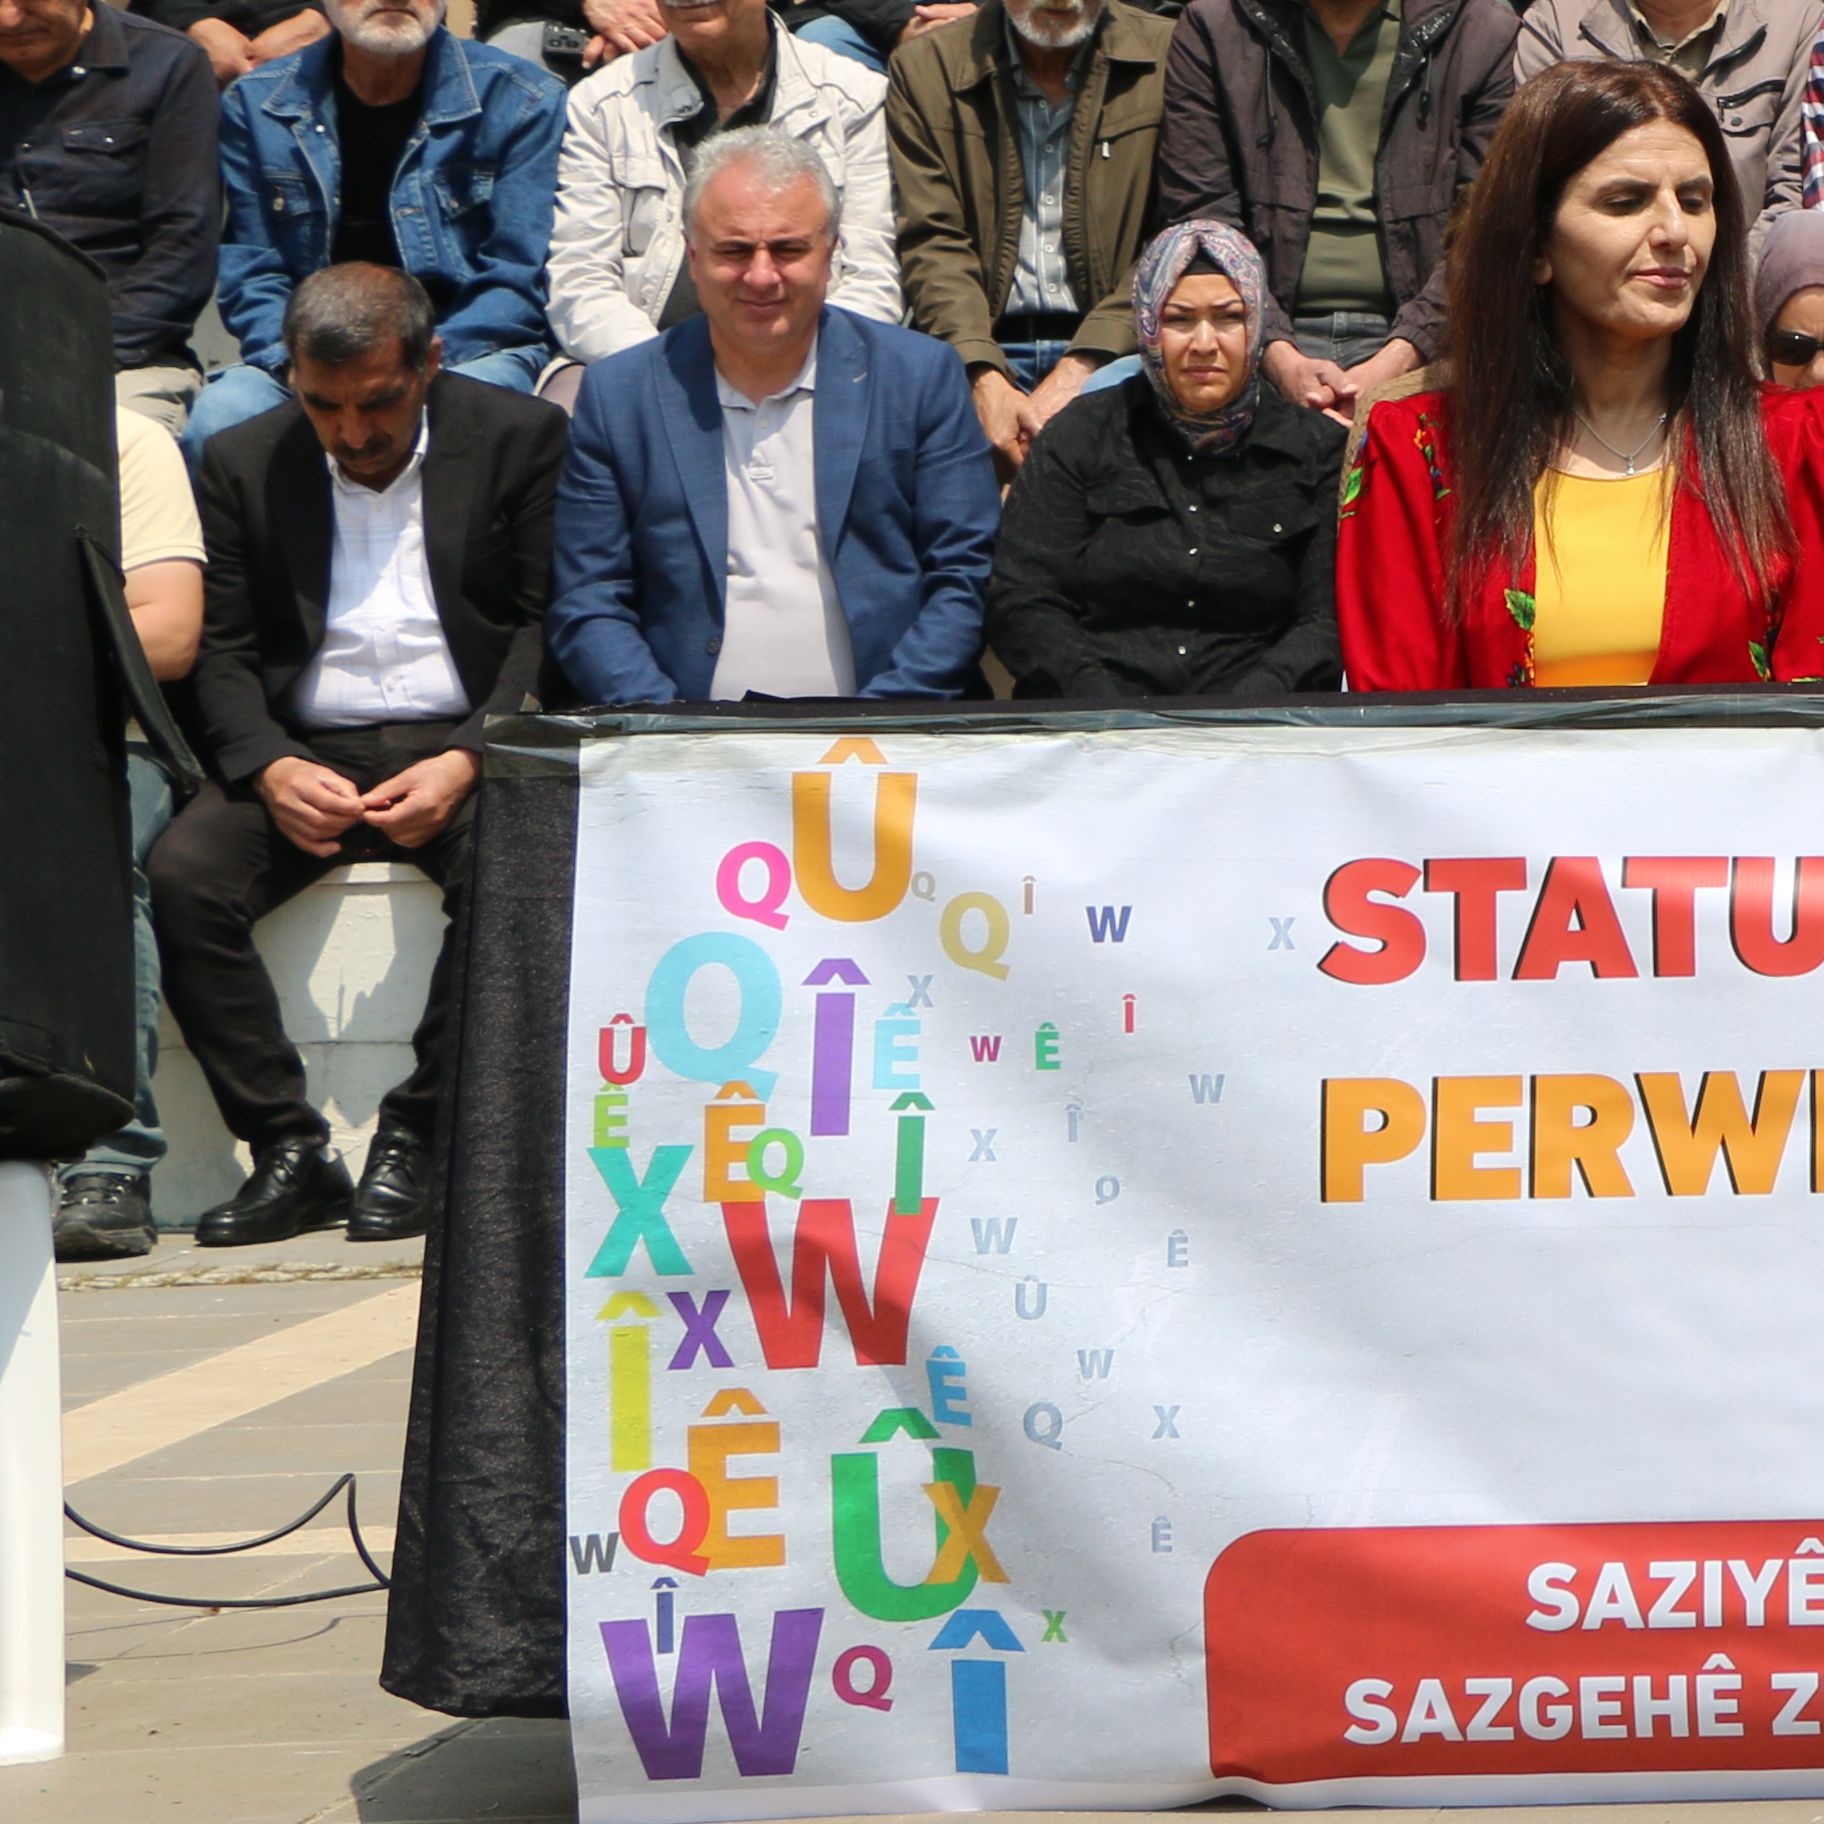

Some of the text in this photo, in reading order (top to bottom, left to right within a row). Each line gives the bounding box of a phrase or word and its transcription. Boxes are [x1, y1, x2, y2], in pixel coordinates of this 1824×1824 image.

[793, 738, 916, 923] Û
[717, 842, 792, 930] Q
[1087, 907, 1132, 943] W
[941, 892, 1010, 980] Q
[598, 1014, 646, 1083] Û
[646, 933, 782, 1102] Q
[803, 959, 870, 1136] Î
[875, 1003, 921, 1089] Ê
[971, 1037, 1001, 1062] W
[1036, 1024, 1060, 1069] Ê
[705, 1082, 765, 1201] Ê
[746, 1128, 803, 1200] Q
[889, 1093, 933, 1214] Î
[586, 1146, 694, 1277] X
[668, 1291, 730, 1369] X
[723, 1199, 939, 1369] W
[598, 1292, 661, 1471] Î
[928, 1346, 971, 1426] Ê
[620, 1469, 710, 1577] Q
[688, 1389, 784, 1567] Ê
[832, 1409, 976, 1621] Û
[570, 1536, 621, 1574] W
[923, 1483, 1009, 1583] X
[1043, 1610, 1067, 1642] X
[600, 1609, 824, 1779] W
[833, 1645, 893, 1710] Q
[930, 1609, 1025, 1774] Î
[1343, 1652, 1745, 1745] SAZGEHÊ
